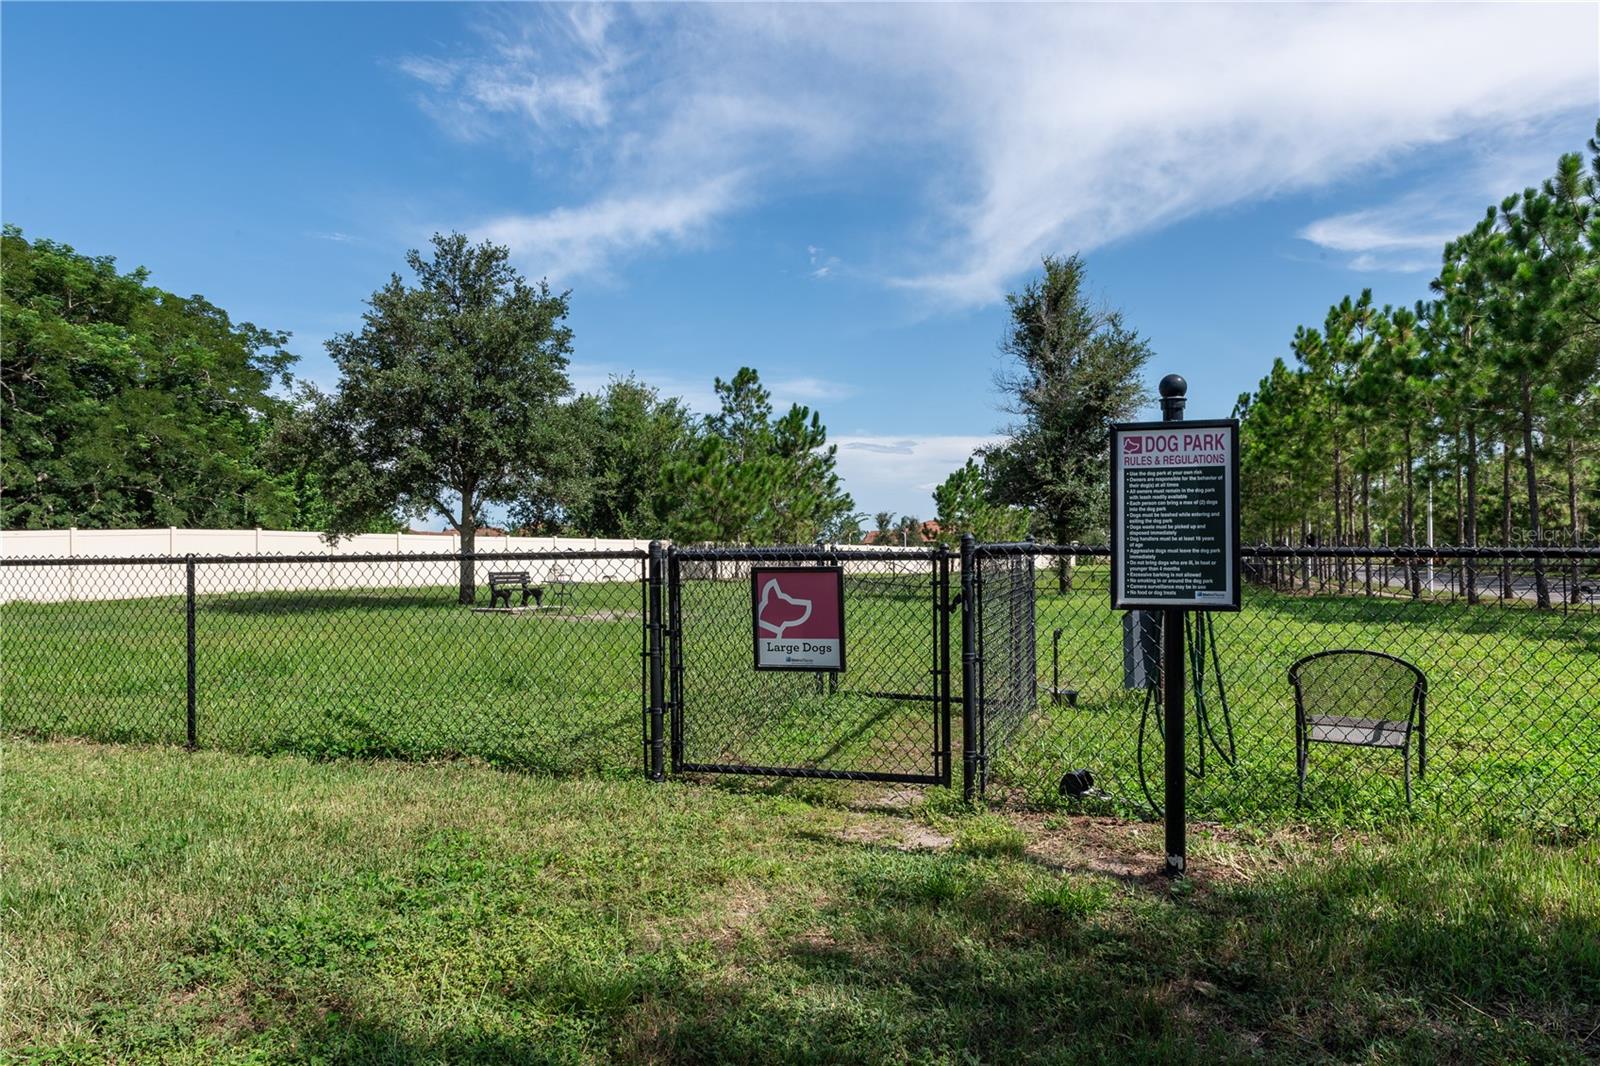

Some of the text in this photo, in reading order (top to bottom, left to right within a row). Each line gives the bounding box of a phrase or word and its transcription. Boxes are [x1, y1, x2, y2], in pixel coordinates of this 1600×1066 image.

[1145, 434, 1225, 452] DOG PARK
[1124, 454, 1224, 466] RULES & REGULATIONS
[767, 642, 832, 654] Large Dogs
